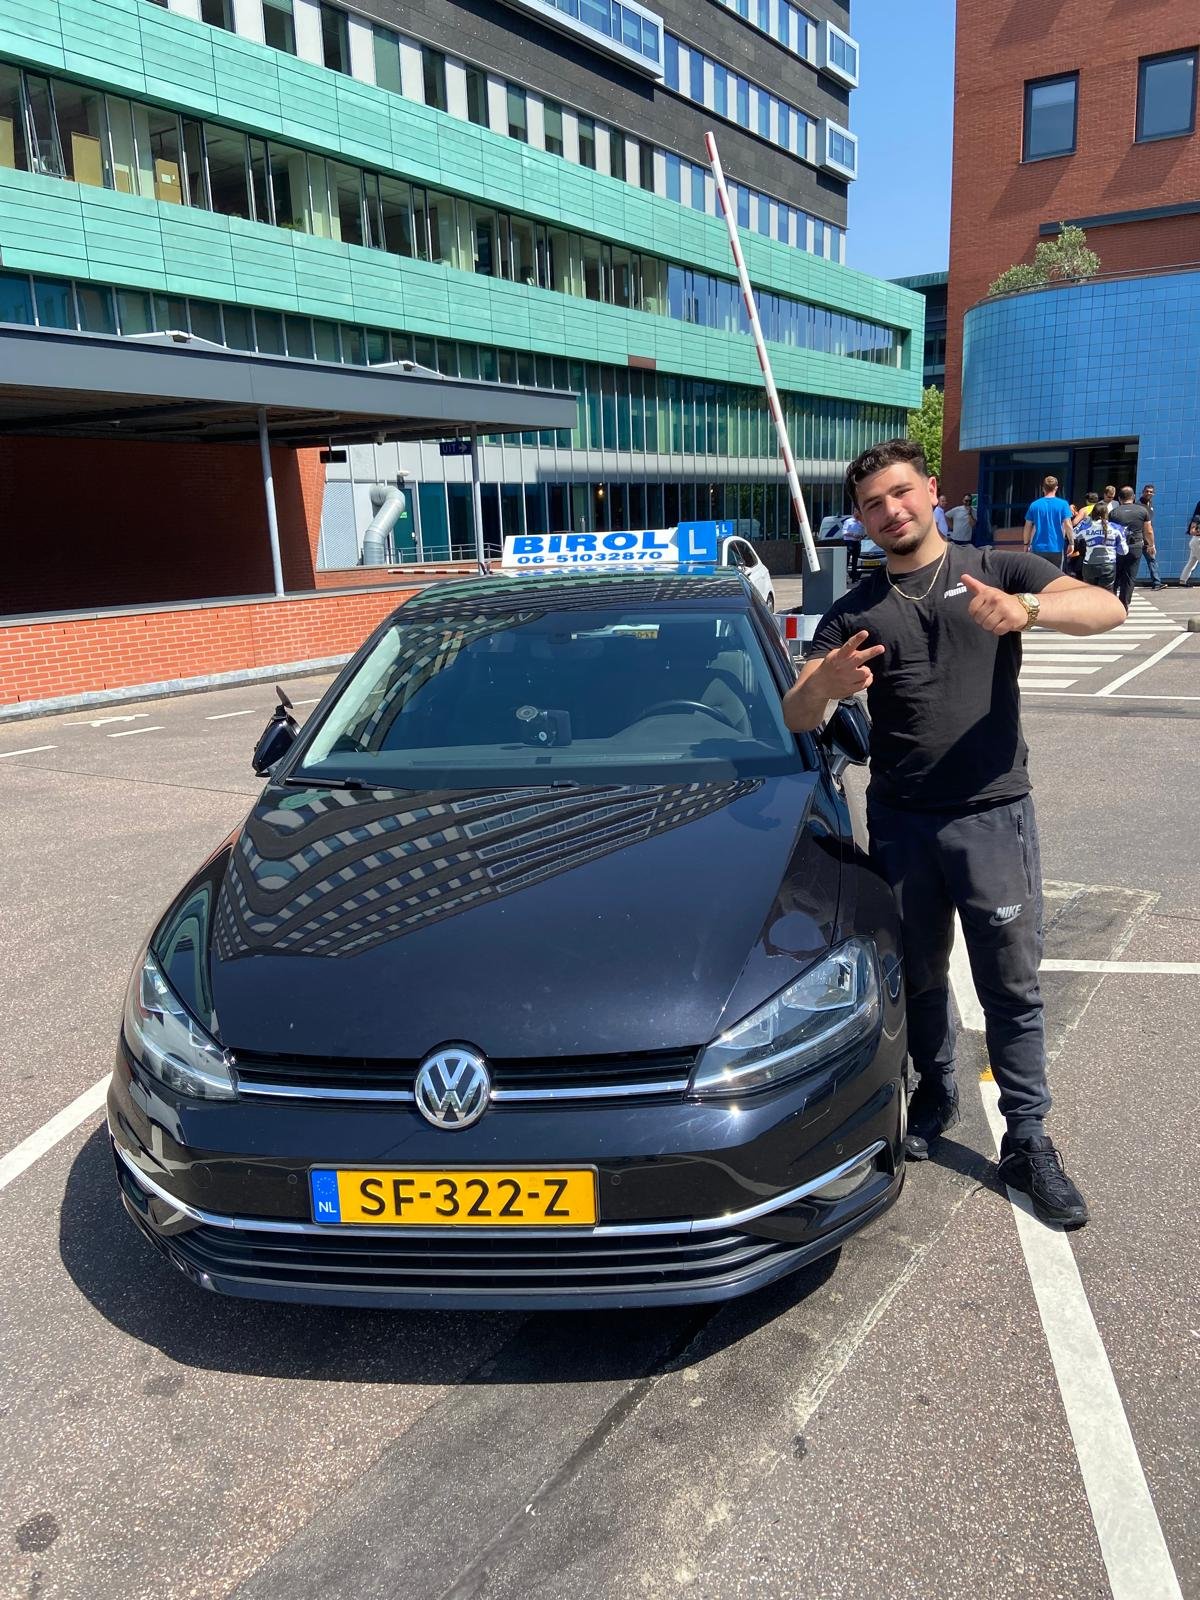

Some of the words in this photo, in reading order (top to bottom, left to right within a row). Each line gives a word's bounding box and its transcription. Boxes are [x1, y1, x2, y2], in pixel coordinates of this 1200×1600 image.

[442, 443, 456, 453] UIT
[512, 531, 669, 555] BIROL
[688, 529, 707, 555] L
[943, 585, 967, 599] PUMA
[996, 904, 1022, 919] NIKE
[359, 1178, 570, 1217] SF-322-Z
[318, 1202, 337, 1214] NL
